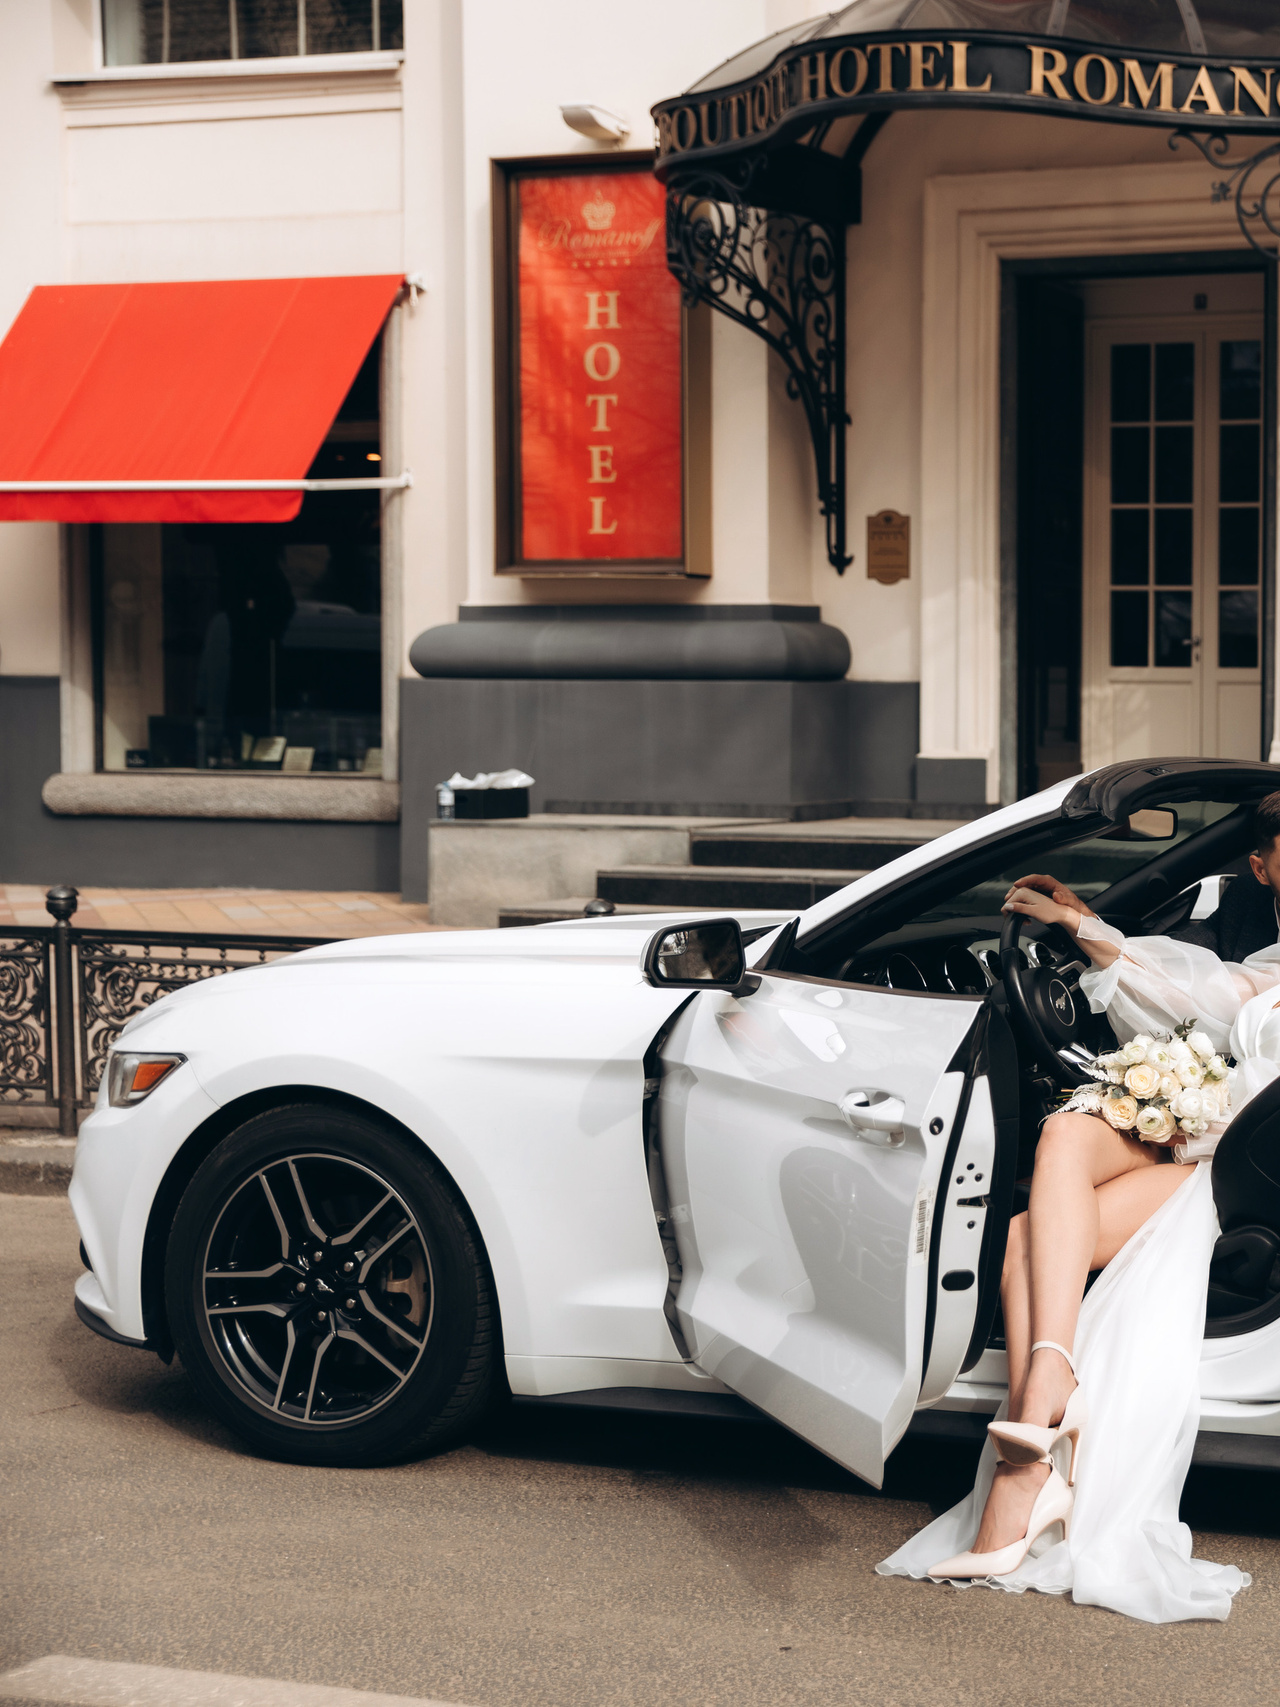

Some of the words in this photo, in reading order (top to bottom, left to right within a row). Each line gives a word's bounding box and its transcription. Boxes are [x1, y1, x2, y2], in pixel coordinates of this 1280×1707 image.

[657, 66, 789, 157] BOUTIQUE
[800, 40, 992, 101] HOTEL
[583, 291, 621, 535] HOTEL
